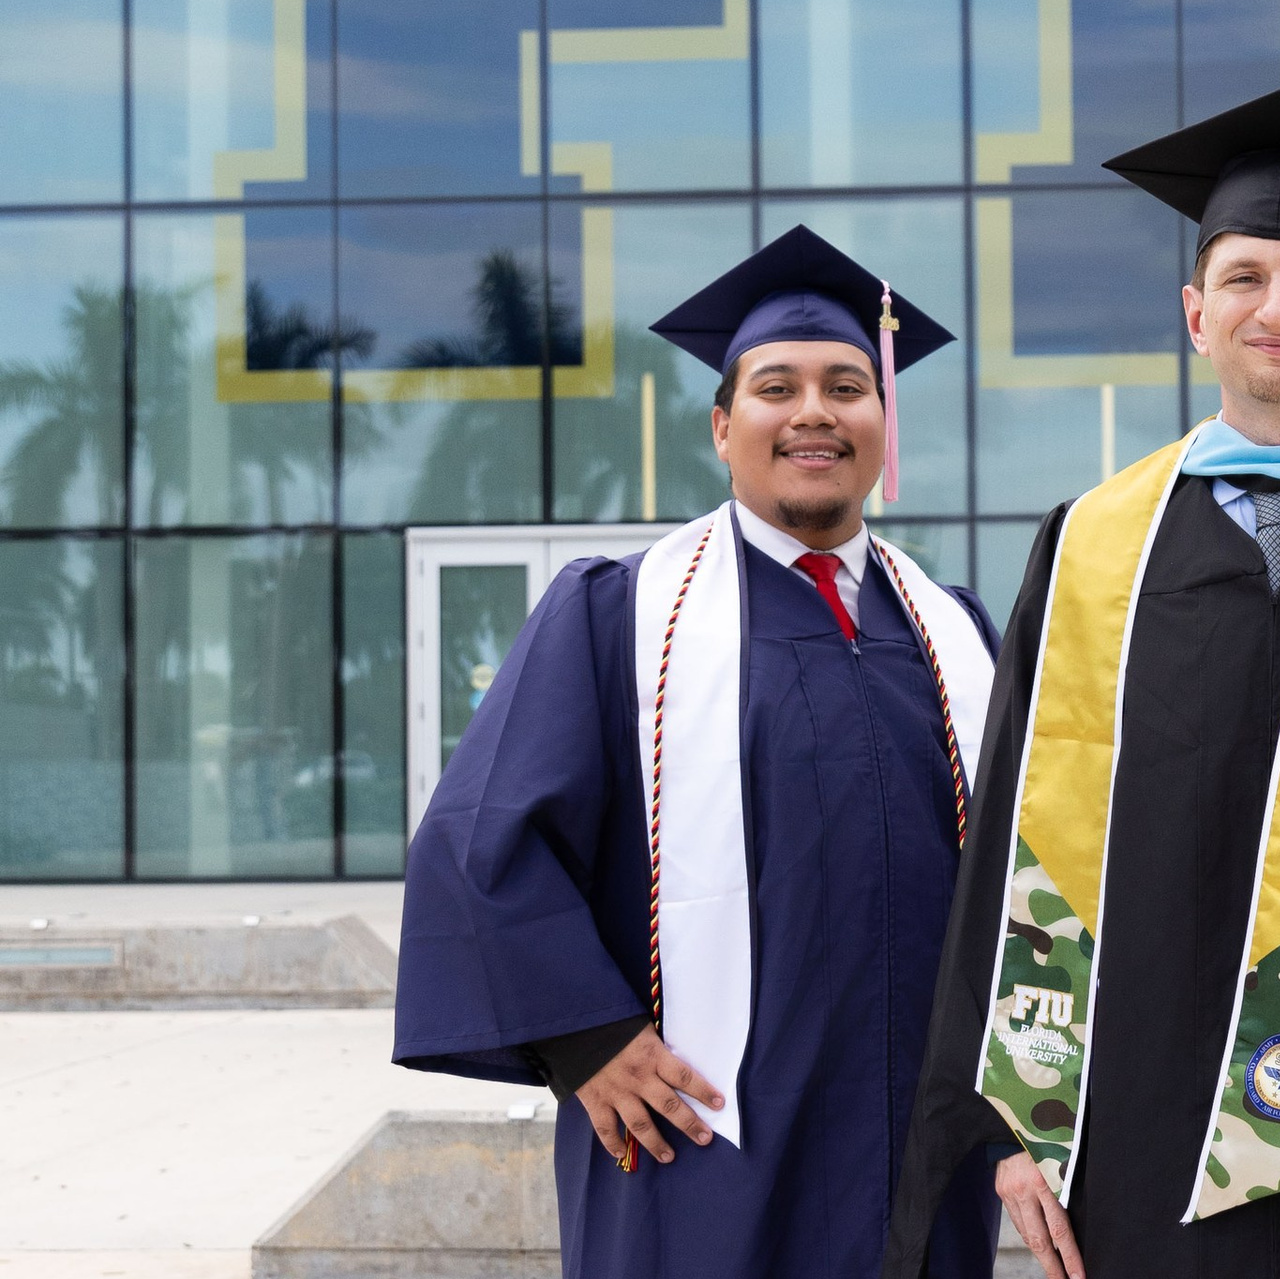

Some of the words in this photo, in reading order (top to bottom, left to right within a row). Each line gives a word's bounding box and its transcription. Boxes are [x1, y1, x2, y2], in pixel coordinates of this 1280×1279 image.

[1011, 984, 1074, 1027] FIU
[1020, 1024, 1062, 1041] FLORIDA
[998, 1031, 1079, 1056] INTERNATIONAL
[1259, 1040, 1275, 1055] ARMY
[1005, 1044, 1067, 1065] UNIVERSITY
